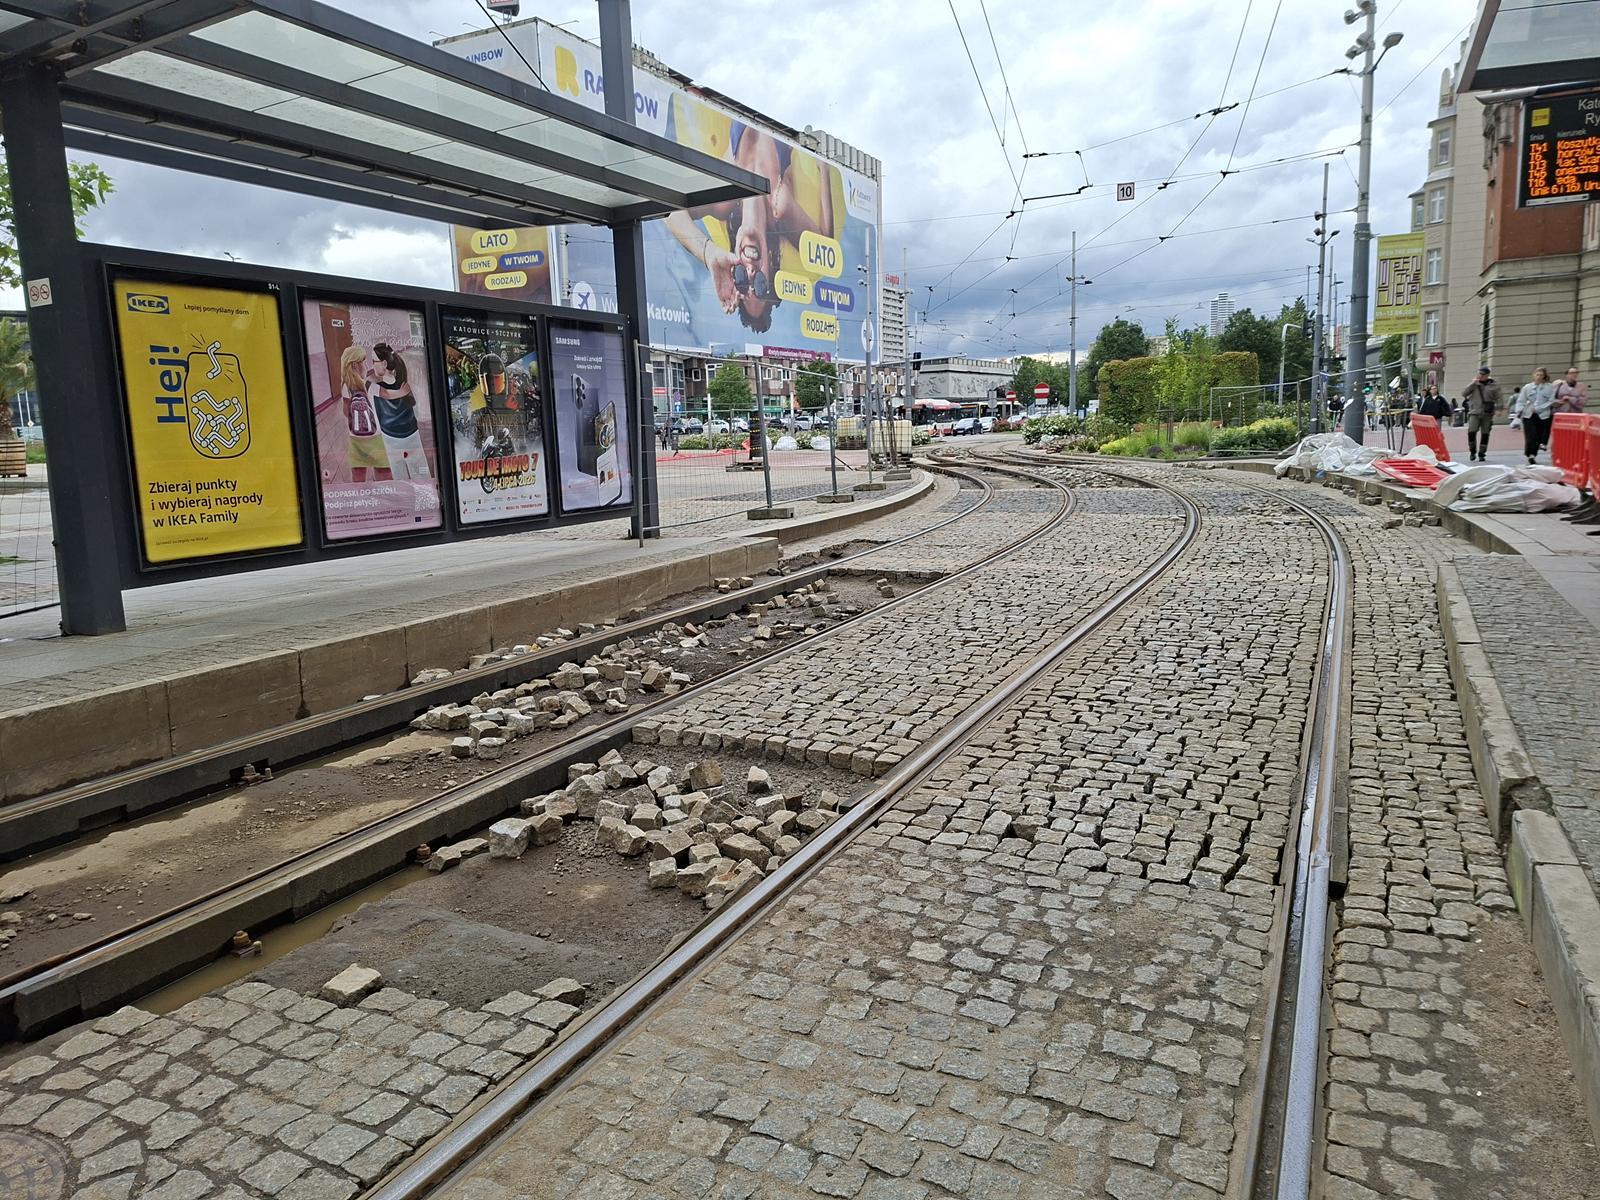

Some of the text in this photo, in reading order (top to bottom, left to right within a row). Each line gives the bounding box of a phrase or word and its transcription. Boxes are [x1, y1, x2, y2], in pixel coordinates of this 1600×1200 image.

[1120, 186, 1132, 197] 10
[480, 233, 508, 249] LATO
[468, 254, 539, 271] JEDYNE W TWOIM
[808, 241, 836, 269] LATO
[491, 275, 521, 285] RODZAJU
[782, 279, 850, 306] JEDYNE W TWOIM
[131, 298, 165, 308] IKEA
[184, 304, 249, 315] Lepiej pomyślany dom
[453, 326, 490, 335] KATOWICE
[495, 330, 521, 338] SZCZYRK
[555, 337, 580, 346] SAMSUNG
[149, 344, 189, 423] Hej!
[459, 452, 539, 481] TOUR DE MOTO 7
[149, 478, 237, 494] Zbieraj punkty
[324, 489, 359, 499] PODPASKI
[360, 488, 371, 496] DO
[151, 492, 263, 512] i wybieraj nagrody
[325, 500, 353, 510] Podpisz
[153, 510, 239, 527] w IKEA Family
